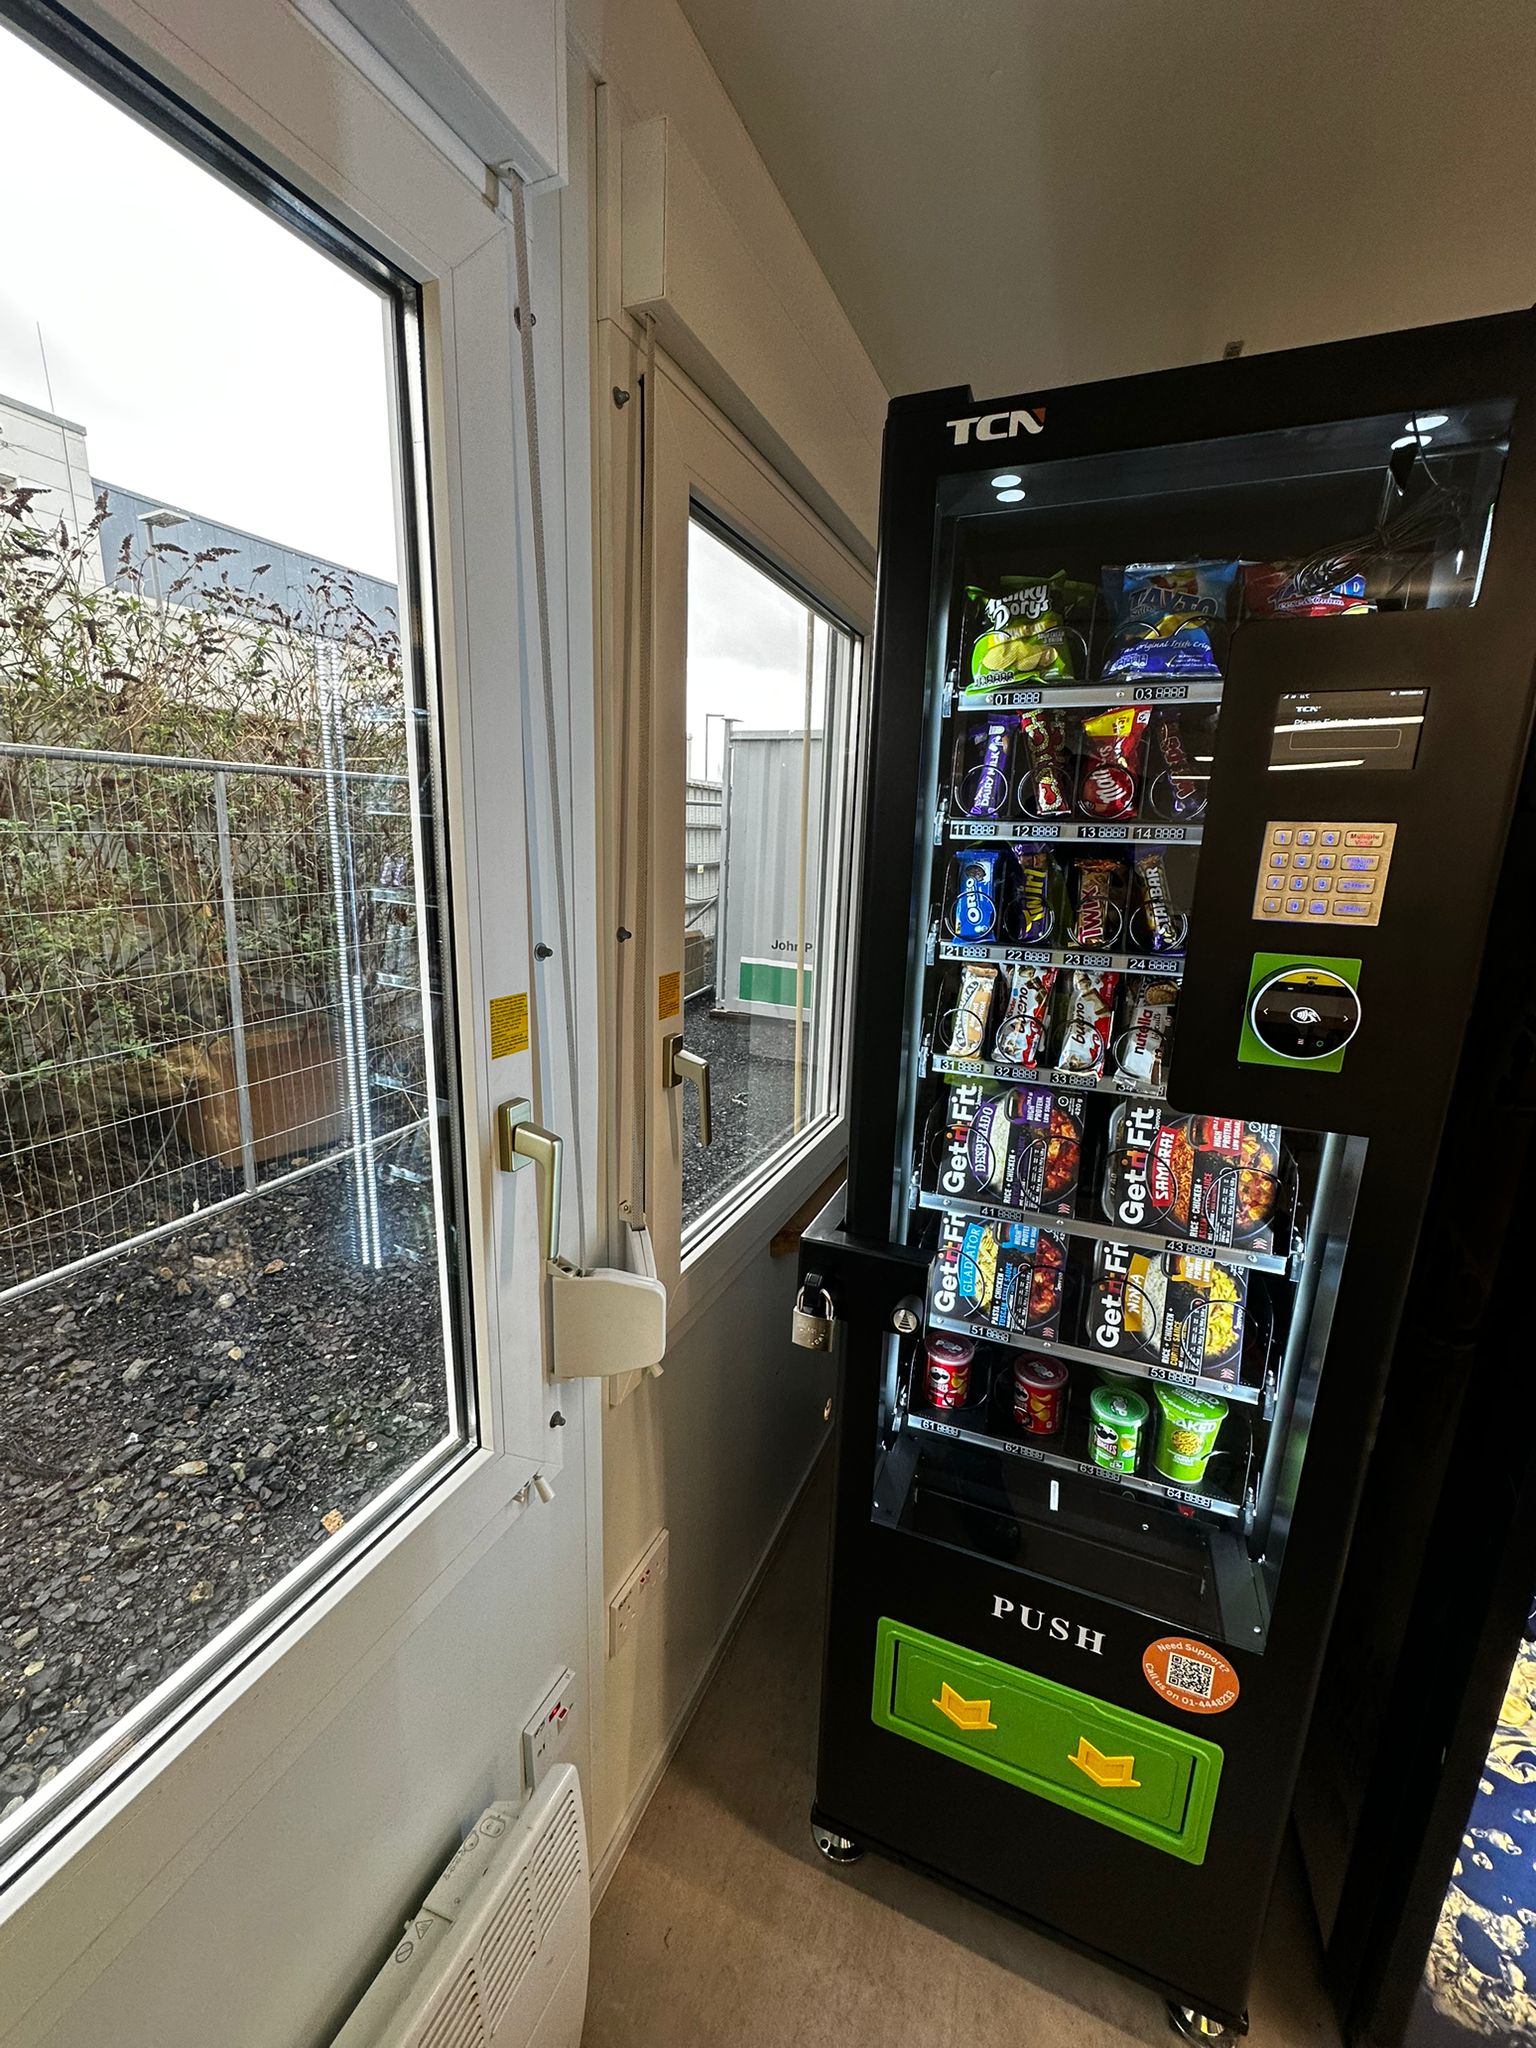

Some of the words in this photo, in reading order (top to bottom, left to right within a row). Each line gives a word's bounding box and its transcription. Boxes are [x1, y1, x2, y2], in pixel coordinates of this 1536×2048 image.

[946, 407, 1046, 445] TCN
[995, 694, 1009, 705] 01
[1136, 688, 1152, 700] 03
[981, 776, 994, 806] DAIRY
[953, 825, 965, 835] 11
[1015, 827, 1029, 836] 12
[1081, 827, 1096, 837] 13
[1136, 828, 1151, 839] 14
[966, 878, 980, 923] OREO
[1078, 885, 1103, 943] TWIX
[946, 946, 960, 957] 21
[1007, 950, 1022, 960] 22
[1065, 955, 1080, 965] 23
[1130, 959, 1145, 969] 24
[1134, 1009, 1153, 1055] nutella
[942, 1060, 954, 1069] 31
[996, 1067, 1010, 1076] 32
[1052, 1074, 1067, 1084] 33
[1213, 1130, 1222, 1148] HIGH
[1006, 1154, 1016, 1182] CHICKEN
[1155, 1131, 1175, 1200] SAMURAI
[1192, 1184, 1202, 1214] CHICKEN
[982, 1207, 994, 1217] 41
[1190, 1221, 1199, 1237] RICE
[1167, 1242, 1183, 1252] 43
[963, 1228, 980, 1293] GLADIATOR
[994, 1273, 1004, 1299] CHICKEN
[971, 1326, 984, 1335] 51
[1164, 1313, 1174, 1341] CHICKEN
[1150, 1368, 1165, 1378] 53
[922, 1420, 935, 1430] 61
[1006, 1443, 1018, 1454] 62
[1080, 1464, 1094, 1475] 63
[1167, 1488, 1181, 1499] 64
[991, 1594, 1107, 1655] PUSH
[1157, 1642, 1183, 1652] Need
[1185, 1643, 1230, 1673] Support?
[1145, 1662, 1159, 1680] Call
[1155, 1680, 1166, 1691] us
[1166, 1689, 1180, 1700] on
